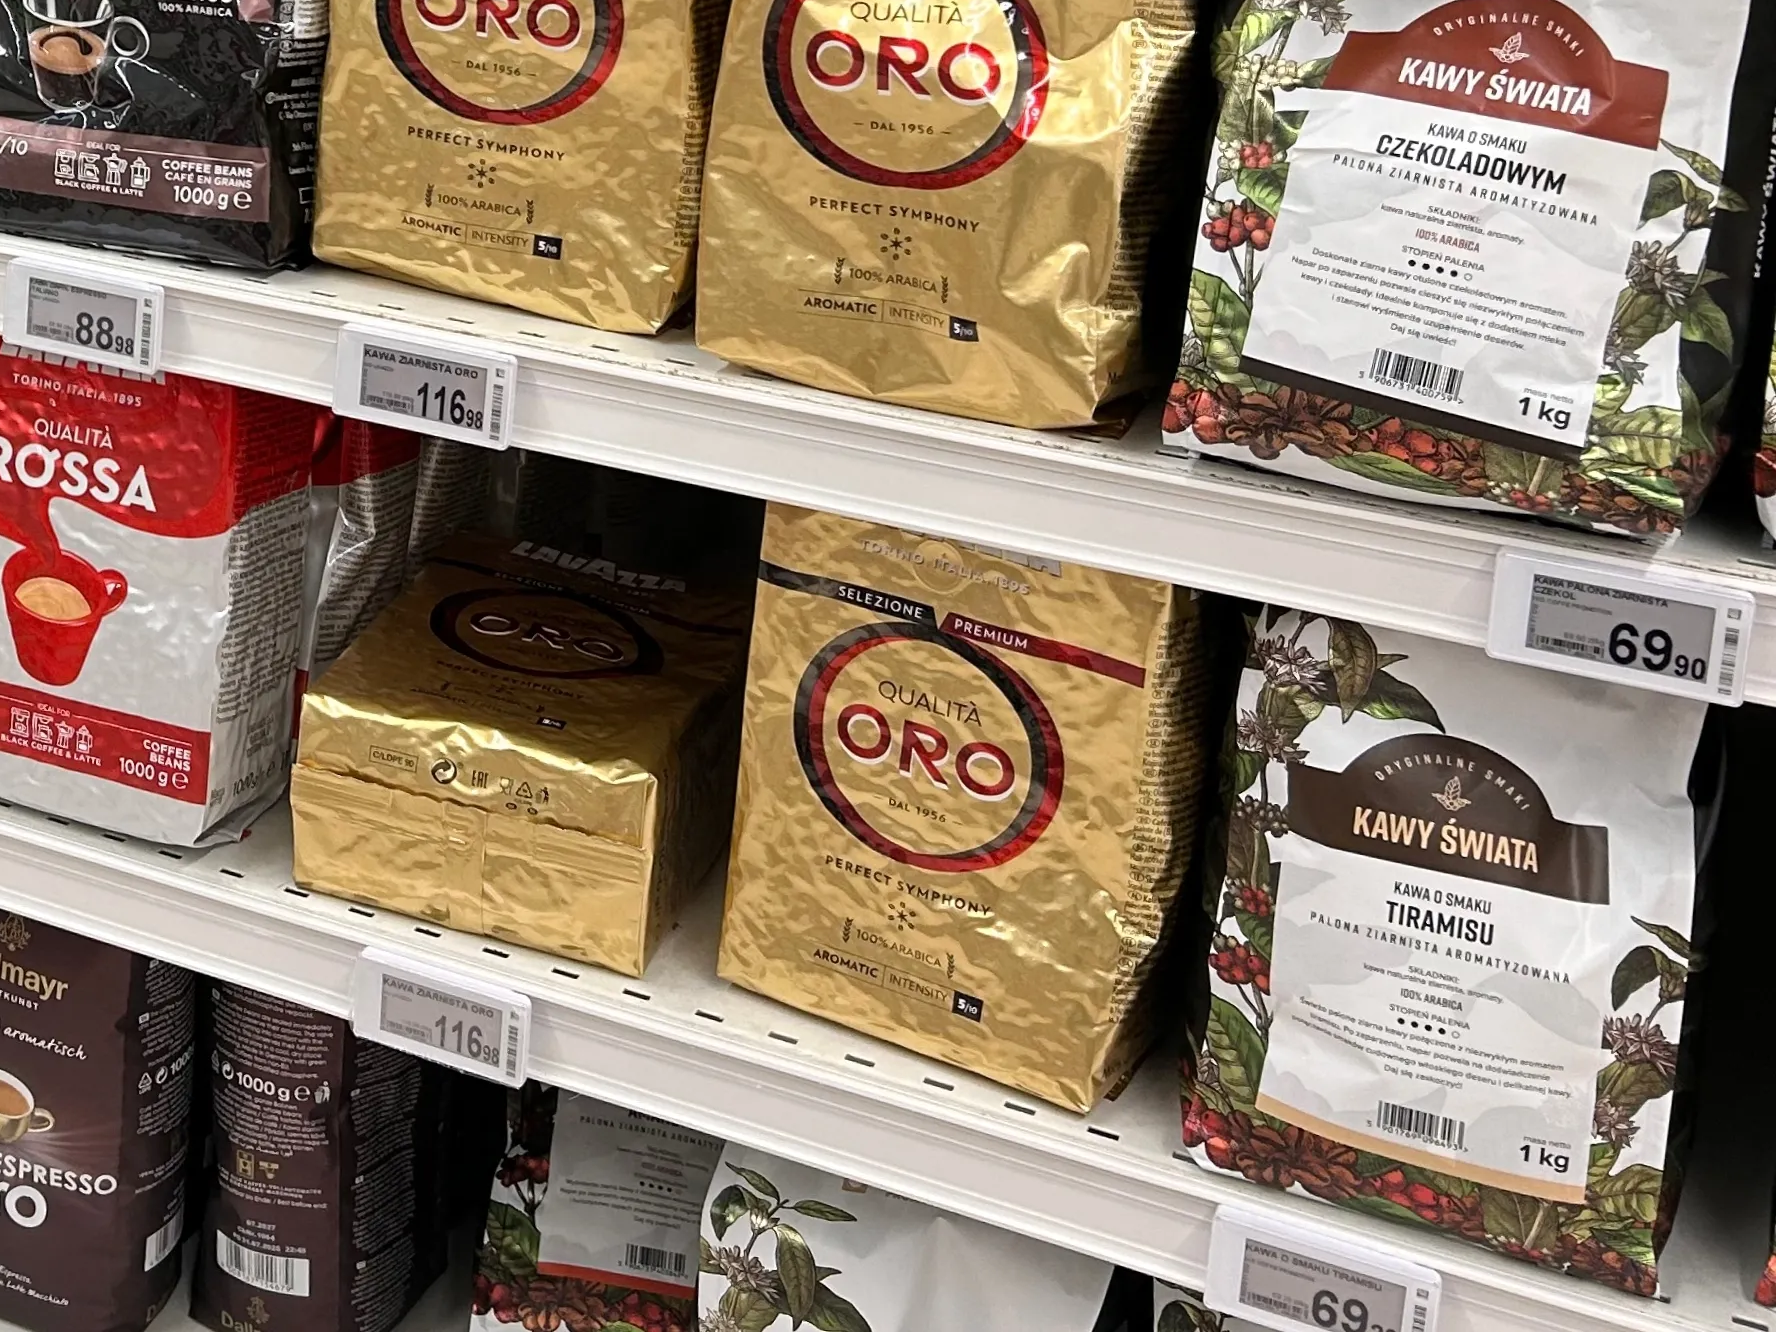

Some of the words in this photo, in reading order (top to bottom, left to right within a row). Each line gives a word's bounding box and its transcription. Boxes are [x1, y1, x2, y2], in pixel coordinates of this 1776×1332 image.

[157, 1, 183, 15] 100%
[185, 4, 233, 18] ARABICA
[466, 59, 489, 72] DAL
[492, 62, 522, 78] 1956
[805, 29, 1002, 107] ORO
[869, 121, 896, 134] DAL
[901, 124, 935, 136] 1956
[1375, 133, 1568, 196] CZEKOLADOWYM
[437, 192, 468, 209] 100%
[470, 197, 522, 217] ARABICA
[809, 196, 883, 218] PERFECT
[888, 204, 981, 233] SYMPHONY
[1444, 255, 1485, 273] PALENIA
[34, 417, 114, 451] QUALITÀ
[510, 541, 687, 595] LAVAZZA
[1533, 586, 1576, 601] CZEKOL
[838, 584, 924, 620] SELEZIONE
[954, 618, 1029, 650] PREMIUM
[469, 613, 626, 664] ORO
[143, 739, 191, 760] COFFEE
[149, 751, 191, 772] BEANS
[836, 703, 1016, 804] ORO
[118, 757, 155, 782] 1000
[157, 765, 170, 787] g
[1374, 753, 1476, 781] ORYGINALNE
[1484, 769, 1531, 811] SMAKI
[888, 797, 912, 813] DAL
[915, 805, 948, 825] 1956
[1353, 806, 1435, 849] KAWY
[1440, 818, 1539, 874] ŚWIATA
[825, 854, 893, 890] PERFECT
[896, 878, 992, 917] SYMPHONY
[1386, 900, 1495, 946] TIRAMISU
[856, 927, 889, 950] 100%
[890, 940, 943, 969] ARABICA
[1384, 1064, 1396, 1075] Daj
[236, 1070, 277, 1098] 1000
[278, 1078, 291, 1104] g
[1520, 1144, 1530, 1162] 1
[1539, 1145, 1570, 1173] kg
[1524, 1136, 1546, 1146] masa
[1549, 1140, 1571, 1150] netto
